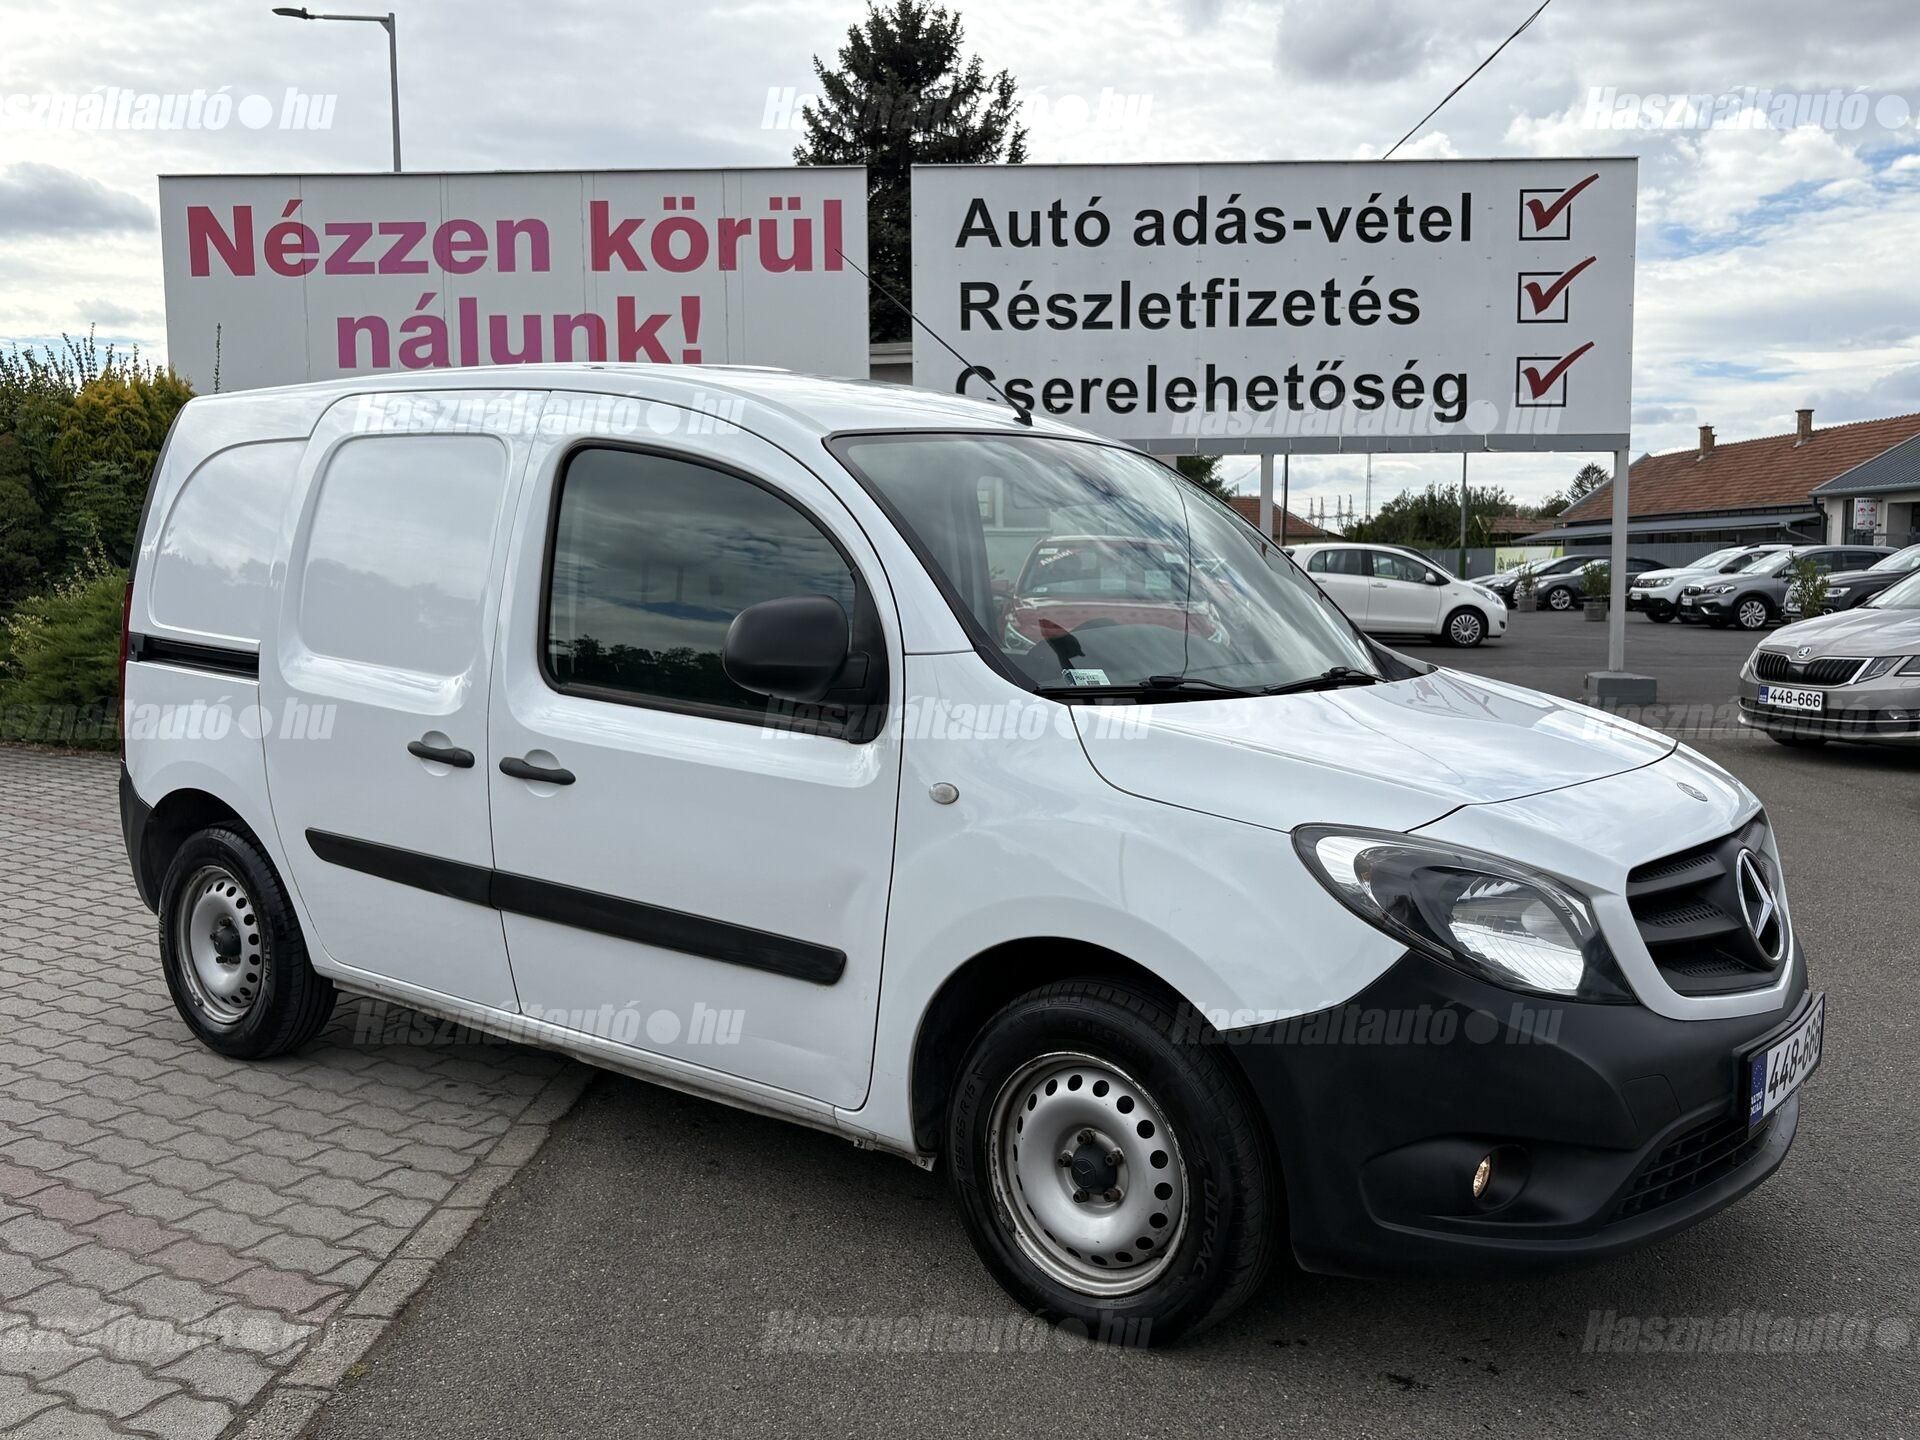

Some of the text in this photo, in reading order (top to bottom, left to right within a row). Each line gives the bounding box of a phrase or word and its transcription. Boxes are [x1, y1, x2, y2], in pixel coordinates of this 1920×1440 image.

[187, 196, 844, 278] Nézzen körül
[955, 192, 1472, 249] Autó adás-vétel
[337, 292, 703, 370] nálunk!
[960, 275, 1420, 331] Részletfizetés
[955, 358, 1469, 424] Cserelehetőség
[1769, 688, 1821, 708] 448-666
[1767, 1010, 1822, 1100] 448-666
